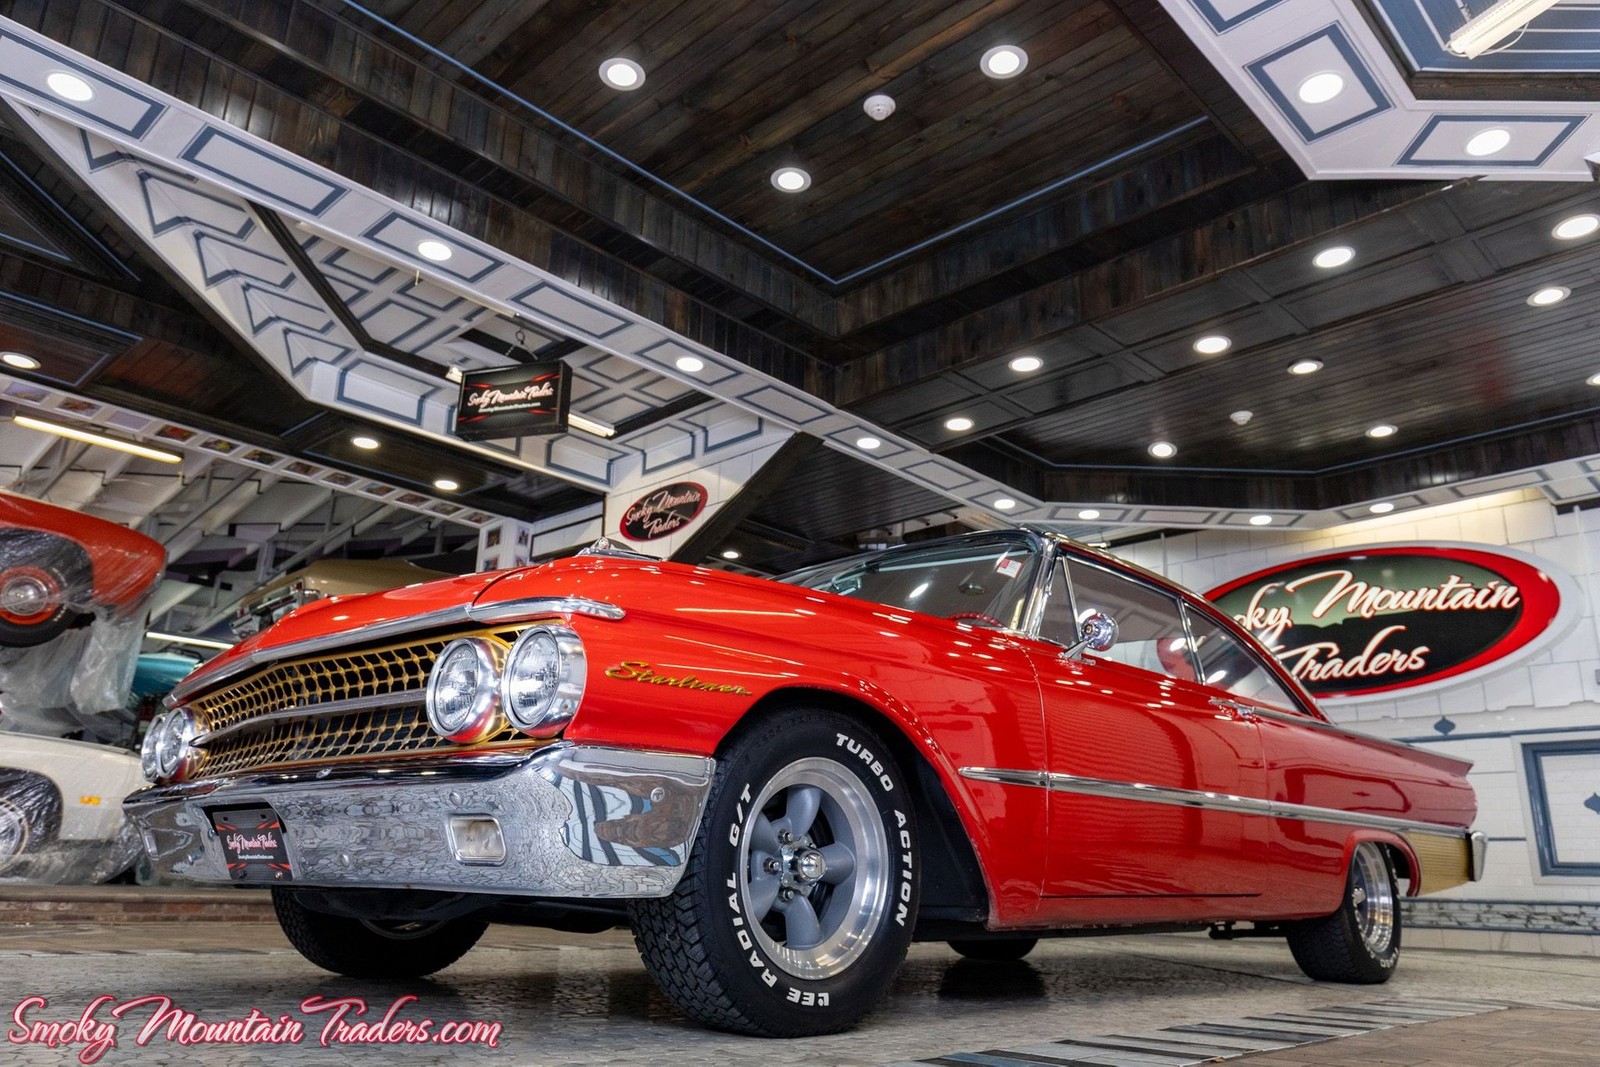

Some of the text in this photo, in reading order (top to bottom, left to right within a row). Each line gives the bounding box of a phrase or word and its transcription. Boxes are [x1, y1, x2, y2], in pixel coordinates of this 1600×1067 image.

[625, 490, 701, 526] Smoky Mountain
[643, 509, 681, 538] Traders
[1285, 570, 1521, 618] Mountain
[1270, 625, 1431, 681] Traders
[605, 661, 753, 696] Starliner
[836, 732, 912, 927] TURBO ACTION
[726, 783, 830, 1007] LEE RADIAL G/T
